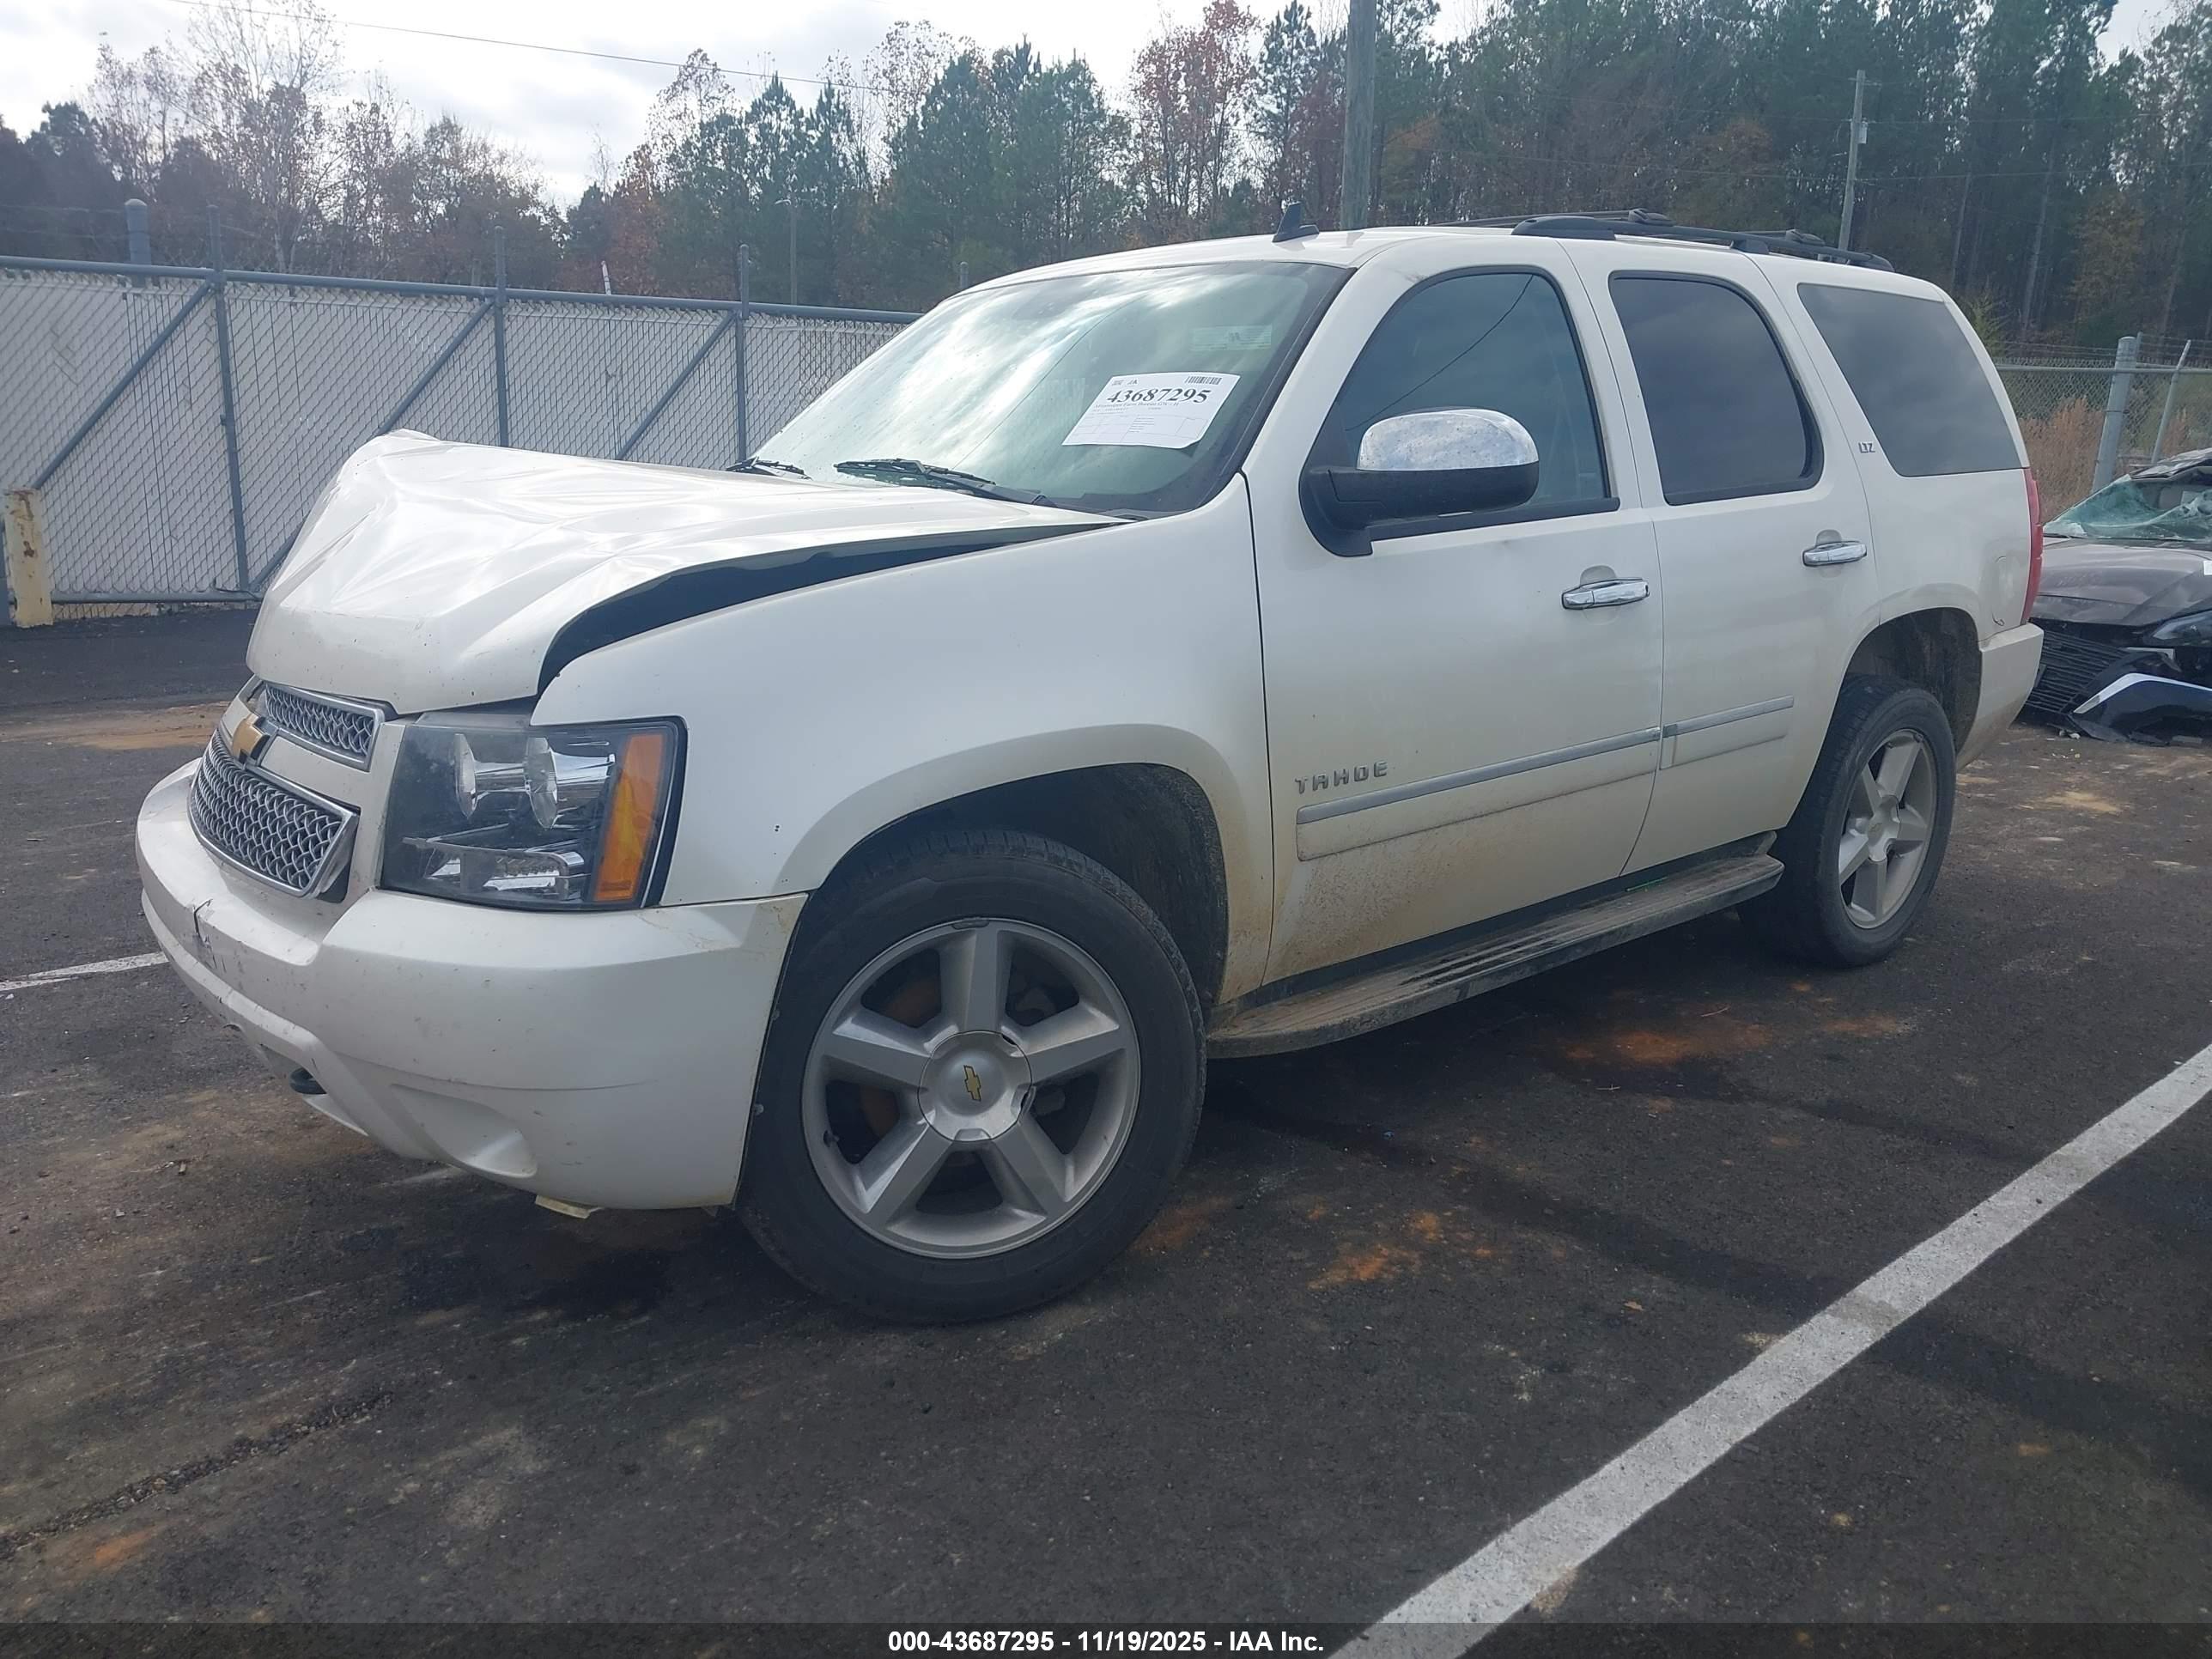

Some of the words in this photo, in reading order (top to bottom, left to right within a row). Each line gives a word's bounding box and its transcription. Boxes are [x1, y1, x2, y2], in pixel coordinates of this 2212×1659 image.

[1107, 387, 1212, 404] 43687295
[1858, 441, 1876, 453] LTZ
[1294, 761, 1389, 795] TAHOE
